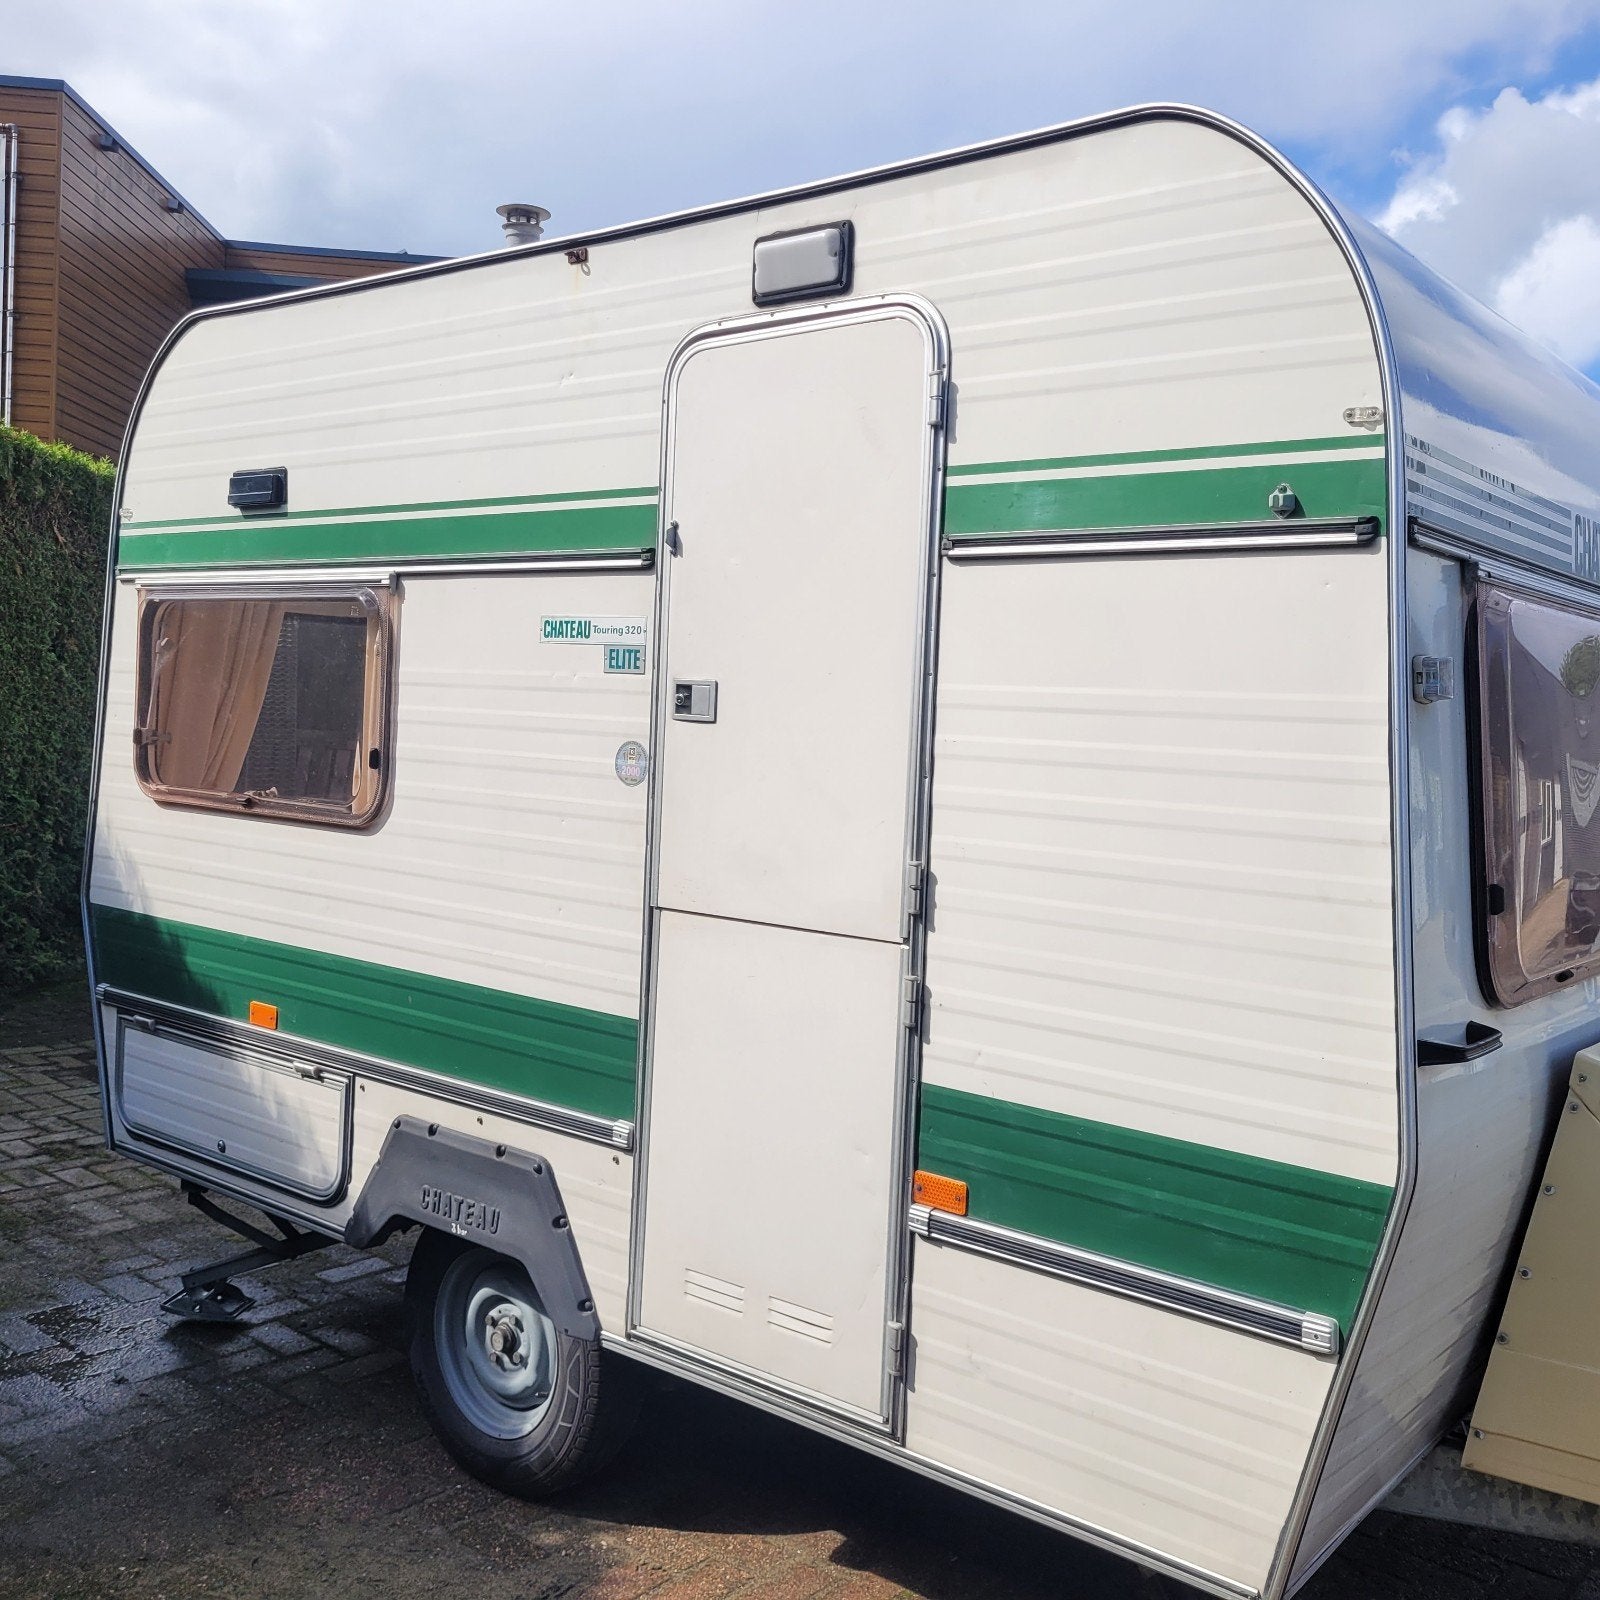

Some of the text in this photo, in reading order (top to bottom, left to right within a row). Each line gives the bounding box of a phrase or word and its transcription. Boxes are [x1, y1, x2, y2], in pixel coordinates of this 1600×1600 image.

[543, 619, 642, 639] CHATEAU Touring 320
[608, 648, 641, 670] ELITE
[421, 1184, 501, 1235] CHATEAU
